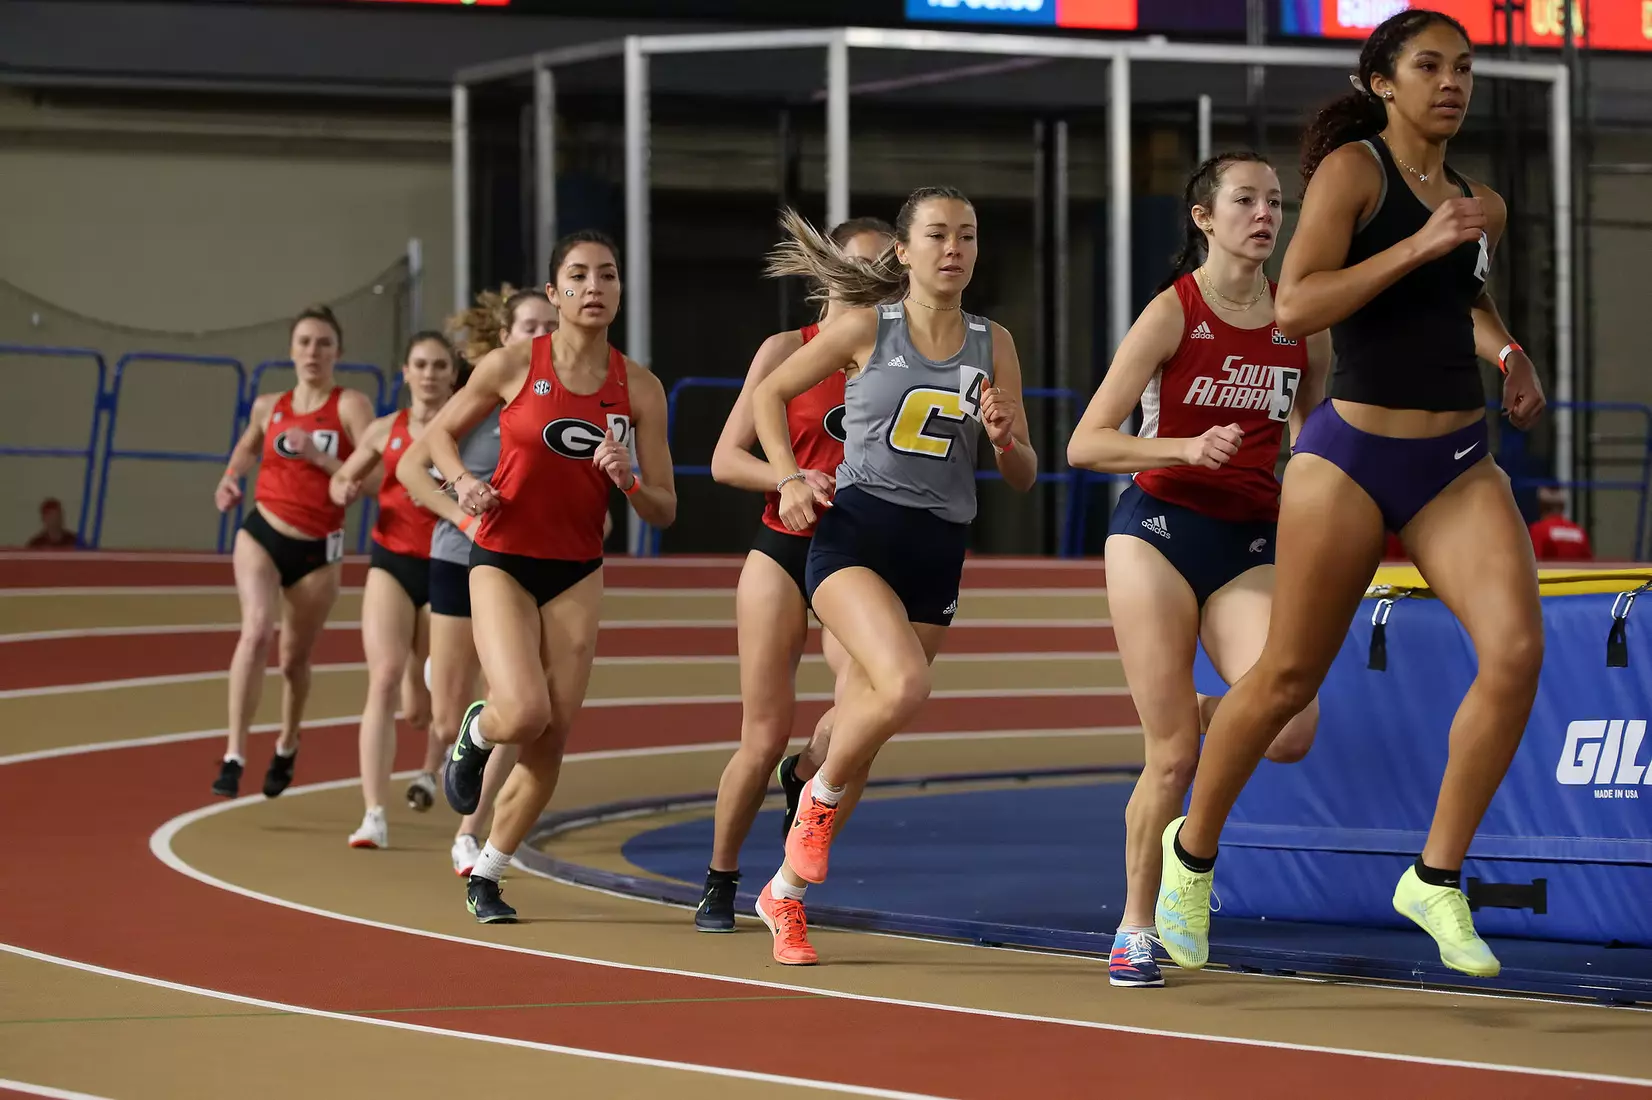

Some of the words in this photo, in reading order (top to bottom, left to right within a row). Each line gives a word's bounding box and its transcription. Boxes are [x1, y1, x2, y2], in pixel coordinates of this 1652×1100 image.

[1190, 332, 1215, 340] adidas
[1215, 355, 1275, 388] SOUT
[534, 380, 551, 395] SEC
[965, 371, 985, 417] 4
[1277, 370, 1298, 420] 5
[885, 384, 968, 462] C
[319, 433, 333, 453] 7
[1141, 519, 1172, 540] adidas
[1556, 719, 1652, 785] GIL
[1594, 789, 1613, 799] MADE
[1614, 789, 1623, 799] IN
[1625, 789, 1639, 799] USA
